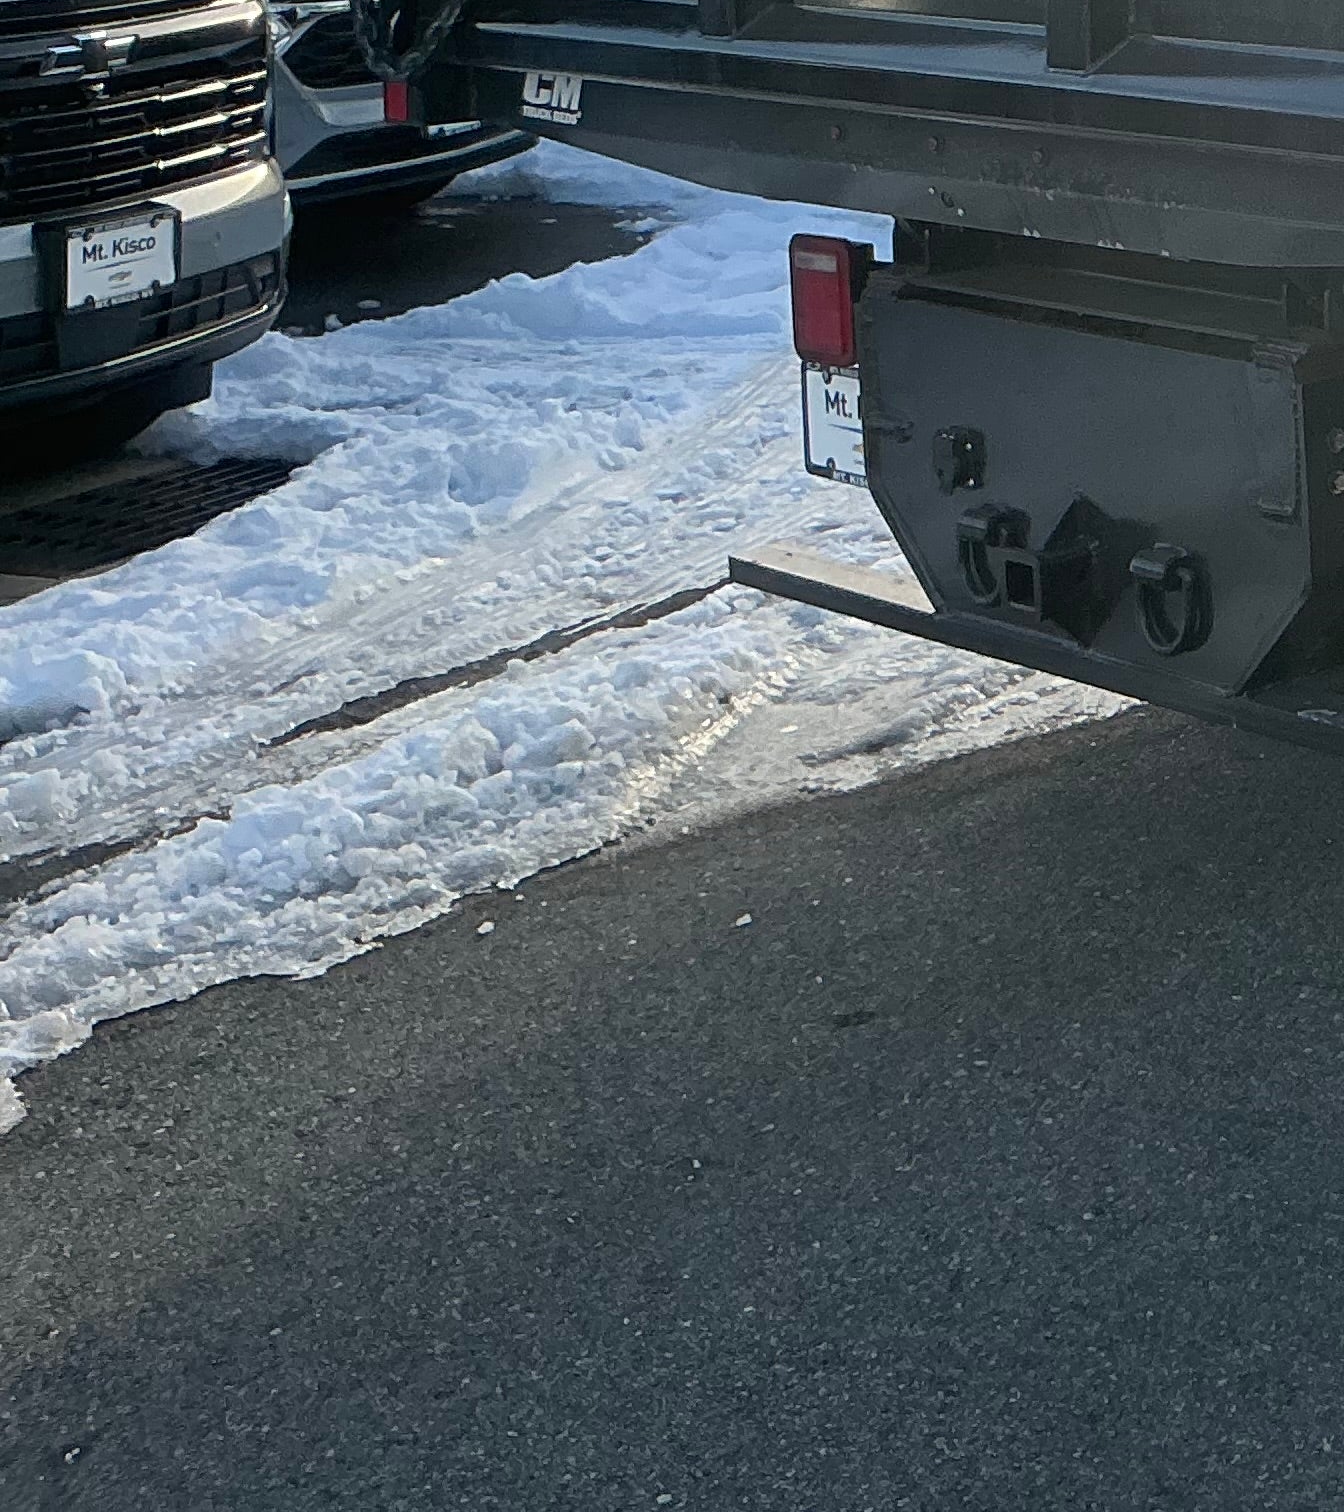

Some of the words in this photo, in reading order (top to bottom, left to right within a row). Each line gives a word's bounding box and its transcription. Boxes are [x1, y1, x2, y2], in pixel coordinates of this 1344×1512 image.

[523, 72, 582, 110] CM
[82, 243, 109, 264] Mt.
[112, 236, 156, 258] Kisco
[824, 388, 853, 419] Mt.
